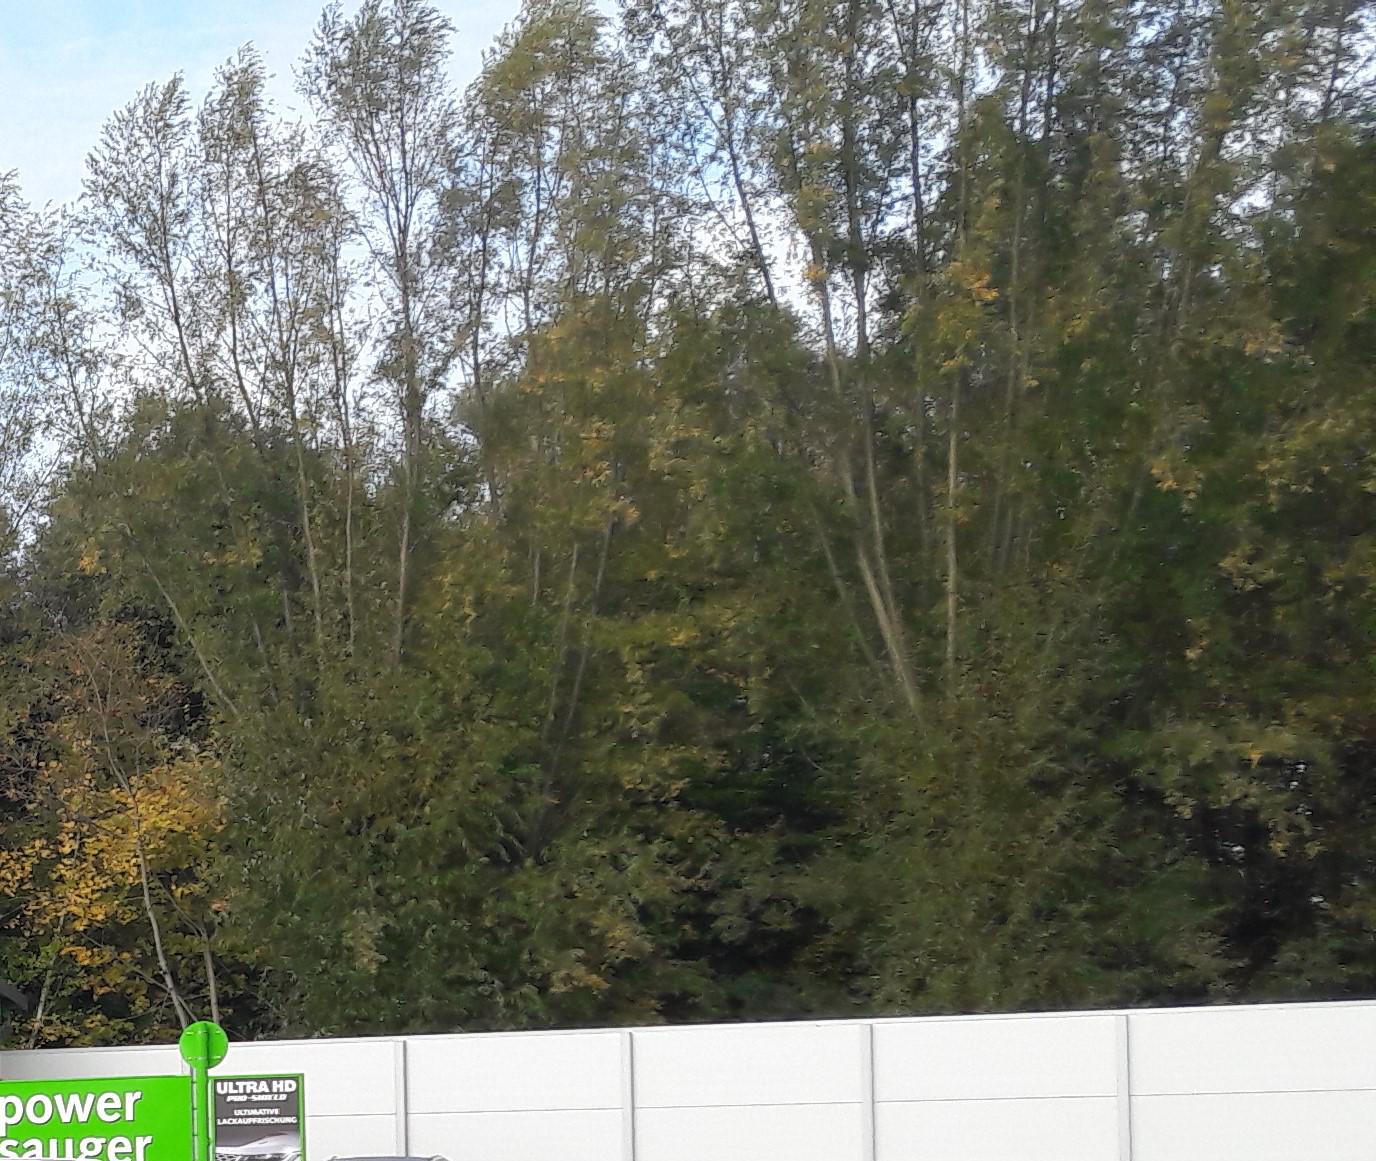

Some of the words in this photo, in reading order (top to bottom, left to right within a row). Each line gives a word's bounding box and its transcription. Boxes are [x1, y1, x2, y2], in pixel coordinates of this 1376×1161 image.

[216, 1081, 269, 1094] ULTRA
[272, 1080, 297, 1092] HD
[233, 1108, 280, 1116] ULTIMATIVE
